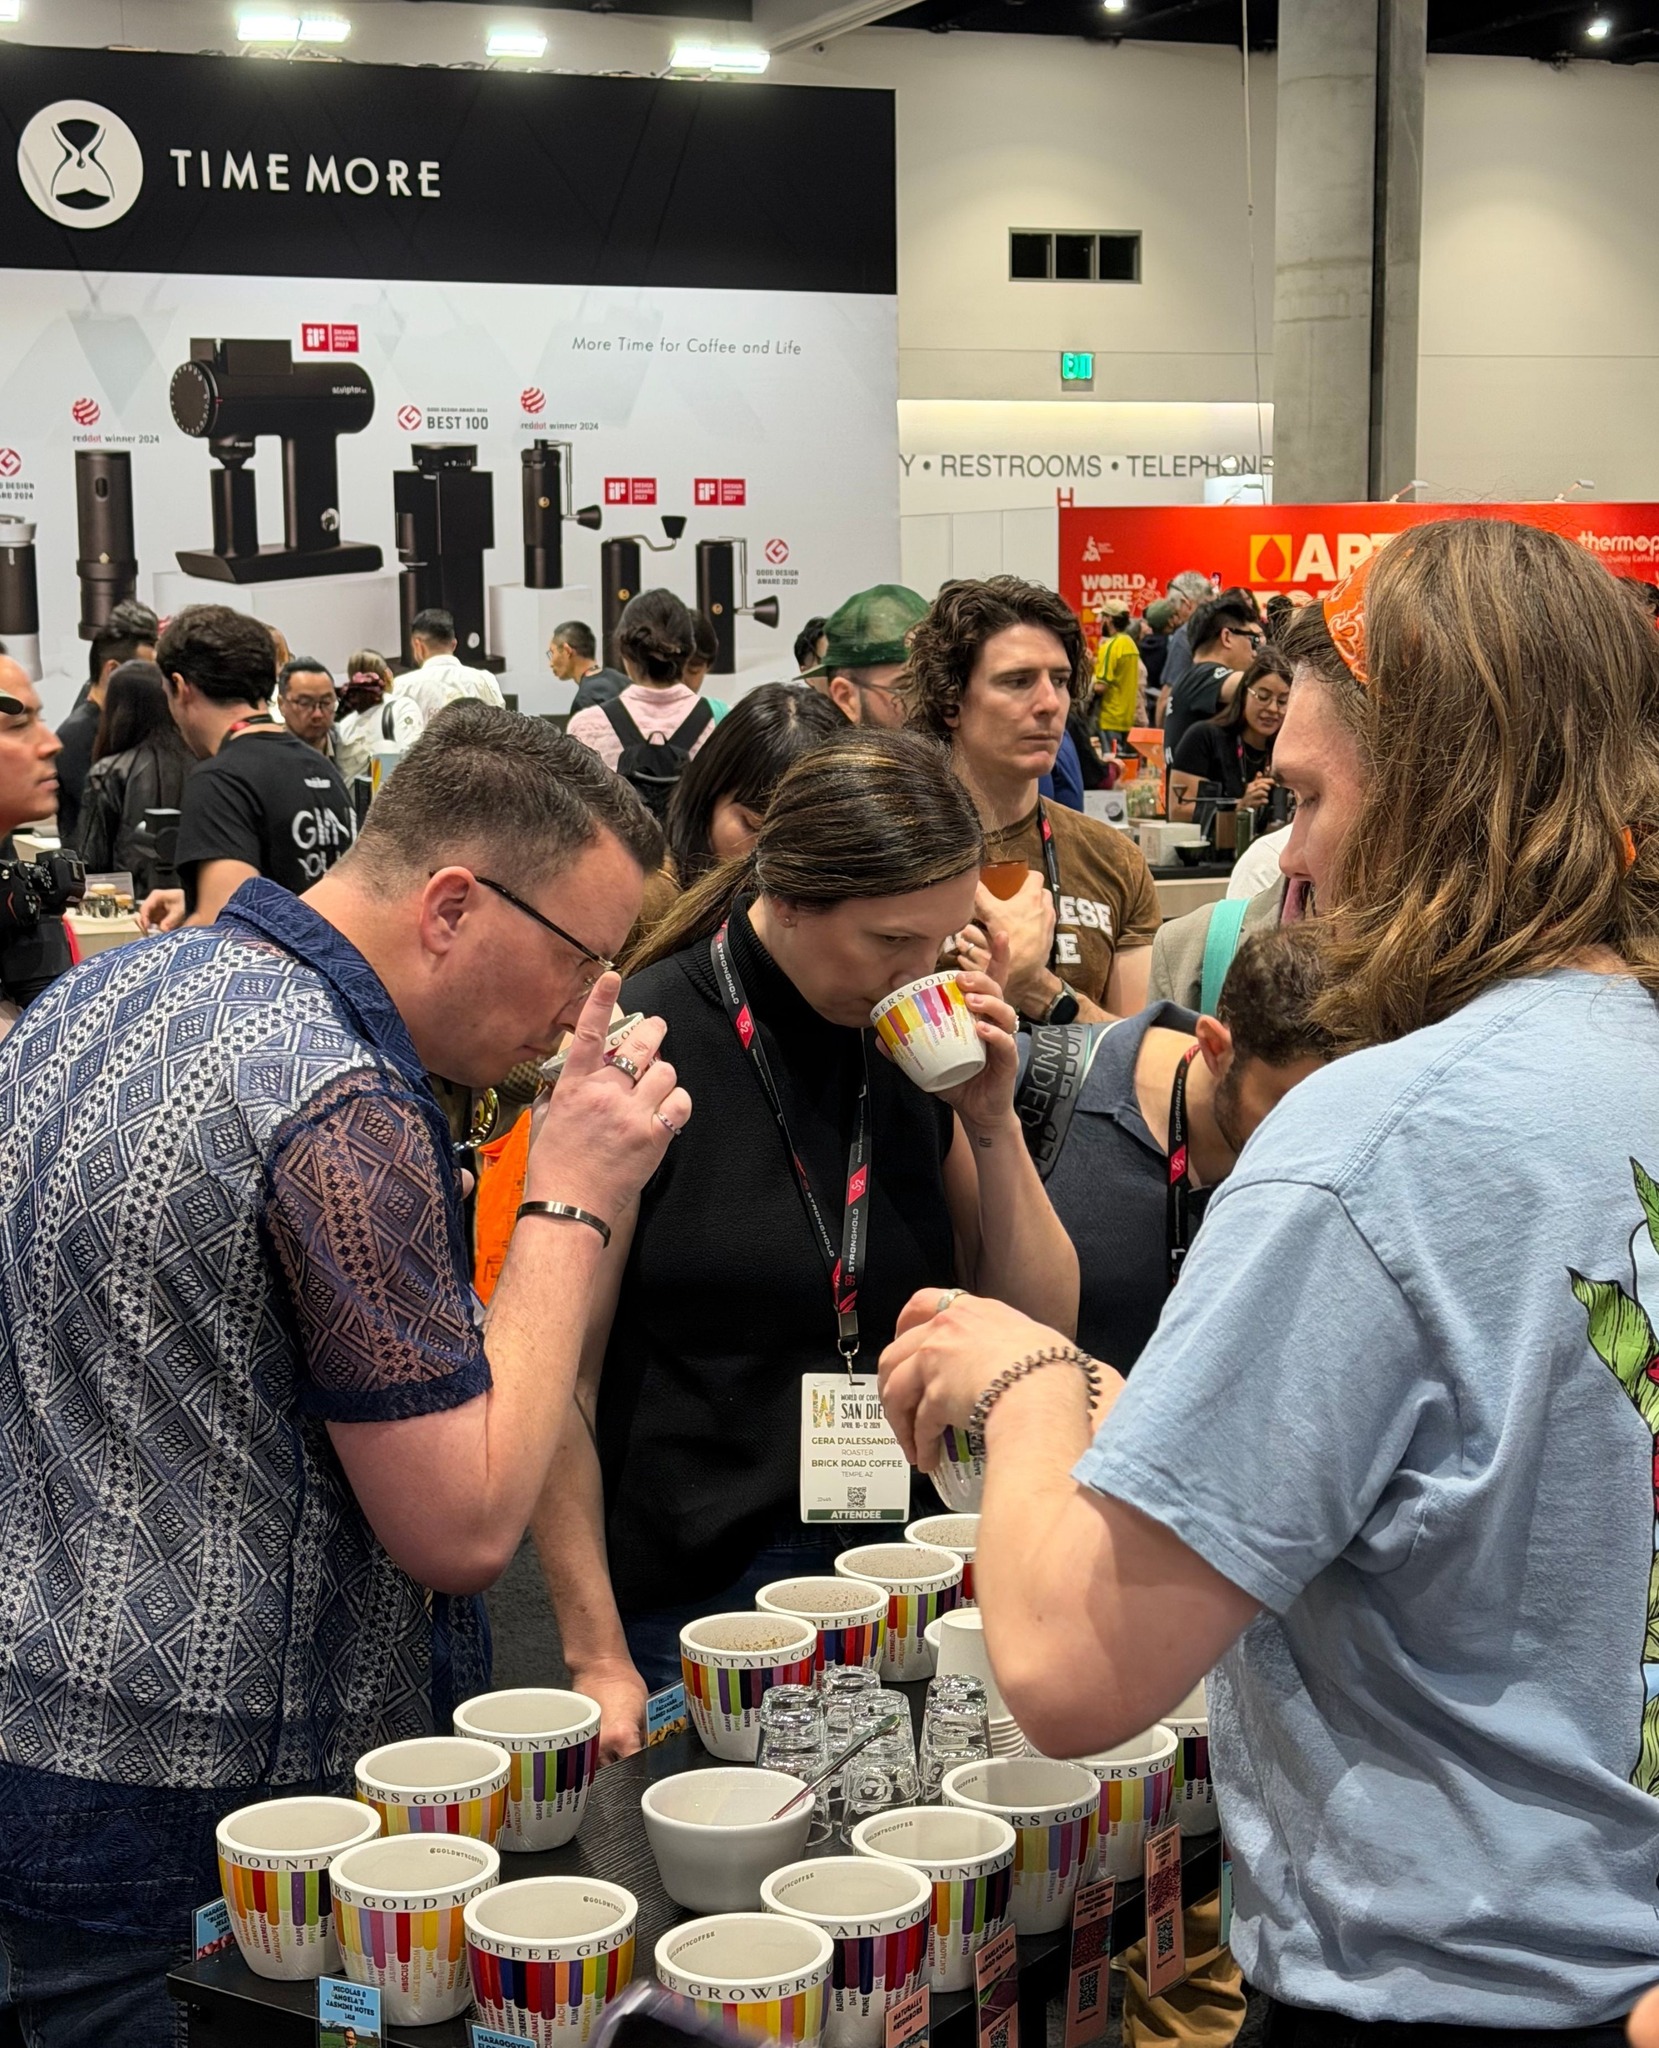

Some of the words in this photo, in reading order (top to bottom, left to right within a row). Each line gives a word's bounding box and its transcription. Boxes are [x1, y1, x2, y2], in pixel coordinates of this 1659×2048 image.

[170, 149, 290, 191] TIME
[305, 153, 441, 198] MORE
[572, 337, 611, 351] More
[618, 337, 654, 352] Time
[660, 337, 680, 352] for
[687, 338, 736, 354] Coffee
[743, 340, 770, 355] and
[775, 340, 802, 355] Life
[427, 416, 461, 429] BEST
[466, 416, 489, 430] 100
[521, 422, 546, 430] reddot
[549, 422, 577, 430] winner
[579, 422, 599, 430] 2024
[73, 434, 102, 443] reddot
[105, 435, 136, 443] winner
[138, 435, 160, 443] 2024
[941, 454, 1102, 477] RESTROOMS
[6, 482, 35, 490] DESIGN
[1081, 574, 1146, 590] WORLD
[717, 943, 740, 1005] STRONGHOLD
[912, 973, 955, 992] GOLD
[807, 1192, 835, 1258] STRONGHOLD
[848, 1208, 859, 1272] STRONGHOLD
[841, 1403, 862, 1419] SAN
[811, 1437, 836, 1445] GERA
[831, 1511, 881, 1519] ATTENDEE
[412, 1787, 481, 1805] GOLD
[556, 1793, 564, 1812] RAISIN
[363, 1896, 438, 1910] GOLD
[259, 1913, 271, 1954] WATERMELON
[295, 1927, 304, 1946] GRAPE
[308, 1927, 316, 1943] APPLE
[320, 1917, 328, 1937] RAISIN
[271, 1927, 283, 1963] CANTALOUPE
[470, 1932, 561, 1960] COFFEE
[425, 1951, 433, 1973] LEMON
[939, 1938, 947, 1975] CANTALOUPE
[388, 1955, 397, 1982] JASMINE
[447, 1963, 456, 1989] ORANGE
[401, 1964, 409, 1993] HIBISCUS
[689, 1972, 820, 2000] GROWERS
[875, 1978, 883, 1989] FIG
[333, 1985, 361, 1997] NICOLAS
[849, 1990, 857, 2006] DATE
[326, 2000, 353, 2011] JASMINE
[354, 2006, 375, 2016] NOTES
[836, 1991, 844, 2011] RAISIN
[862, 1996, 870, 2016] PRUNE
[557, 2005, 565, 2026] PEACH
